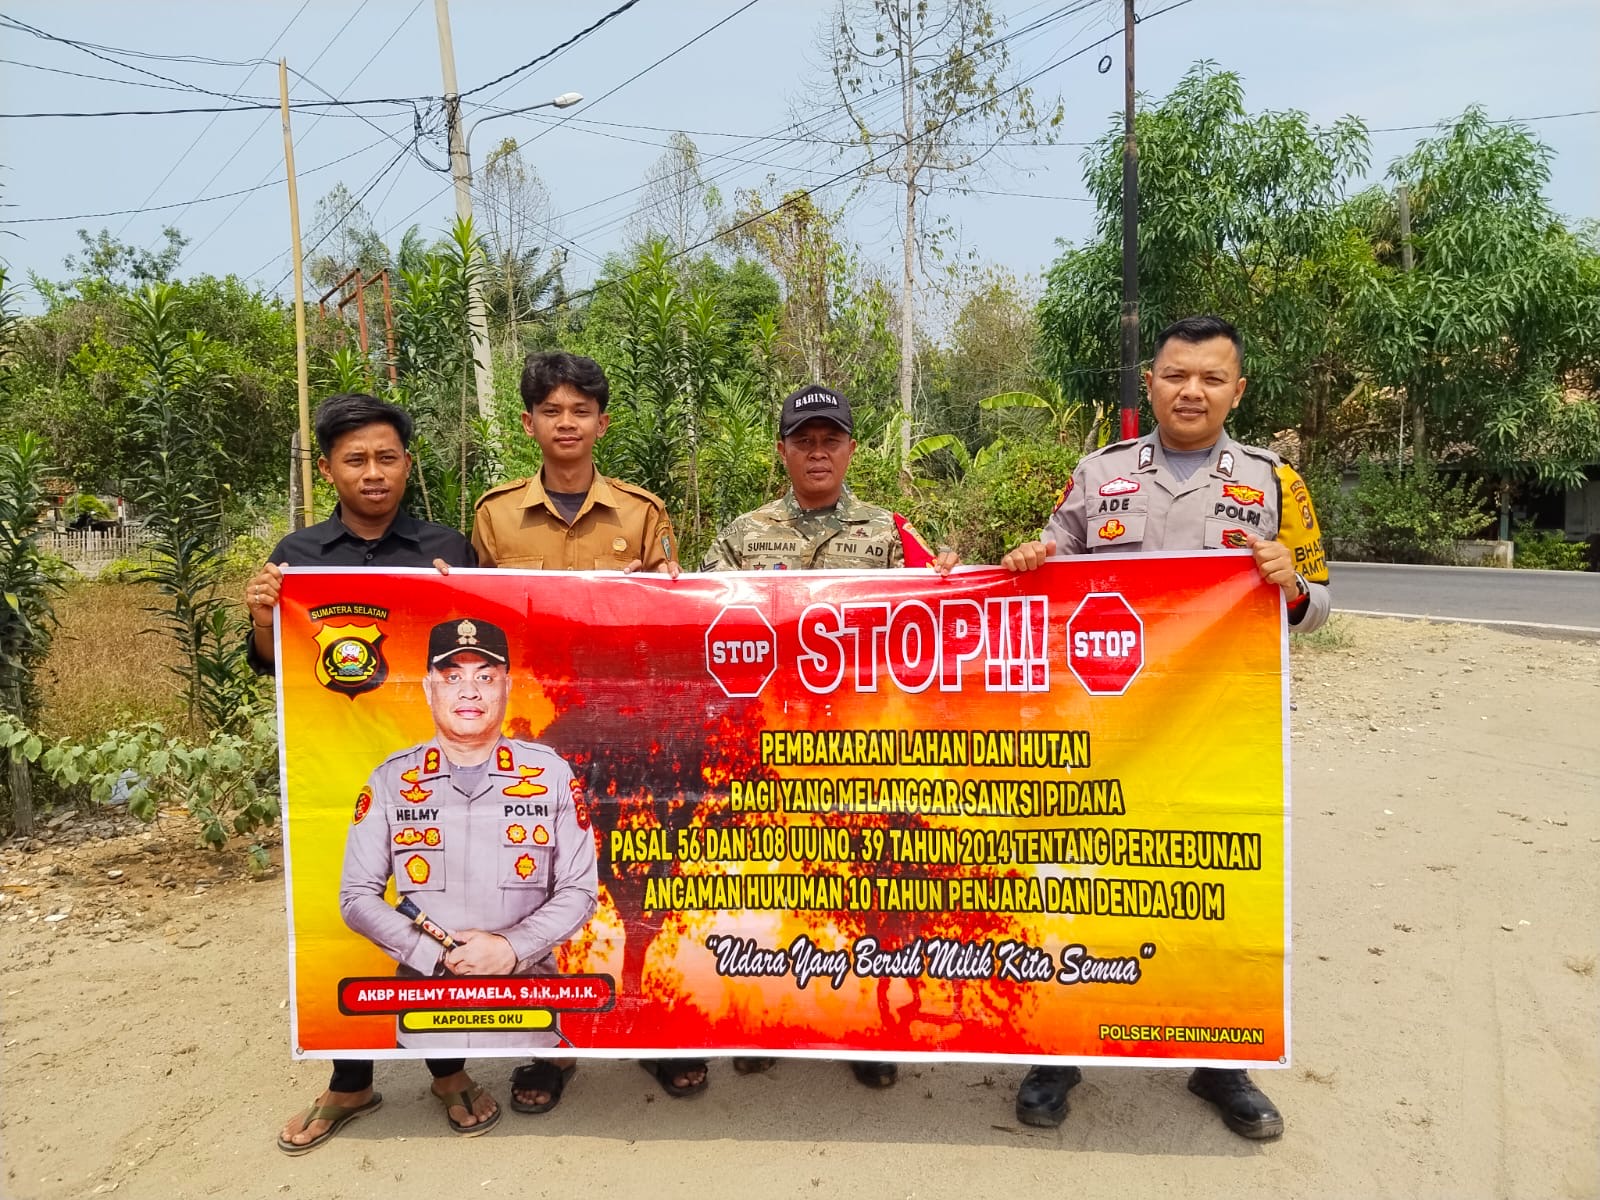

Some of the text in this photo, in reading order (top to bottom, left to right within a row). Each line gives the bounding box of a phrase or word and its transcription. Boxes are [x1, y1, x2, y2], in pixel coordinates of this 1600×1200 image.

[795, 393, 838, 408] BABINSA
[1099, 498, 1130, 513] ADE
[1214, 502, 1261, 526] POLRI
[748, 542, 796, 551] SUHILMAN
[835, 543, 883, 557] TNI AD
[311, 605, 387, 619] SUMATERA SELATAN
[712, 640, 770, 664] STOP
[797, 595, 1050, 695] STOP!!!
[1074, 630, 1137, 657] STOP
[761, 731, 1089, 767] PEMBAKARAN LAHAN DAN HUTAN
[730, 780, 1124, 816] BAGI YANG MELANGGAR SANKSI PIDANA
[396, 809, 440, 821] HELMY
[504, 804, 548, 817] POLRI
[610, 828, 1260, 870] PASAL 56 DAN 108 UU NO. 39 TAHUN 2014 TENTANG PERKEBUNAN
[644, 876, 1224, 919] ANCAMAN HUKUMAN 10 TAHUN PENJARA DAN DENDA 10 M
[790, 937, 850, 986] Yang
[855, 940, 922, 977] Bersih
[927, 942, 993, 979] Milik
[998, 944, 1053, 981] Kita
[357, 990, 395, 1002] AKBP
[398, 989, 444, 1001] HELMY
[448, 987, 517, 1000] TAMAELA,
[433, 1014, 523, 1025] KAPOLRES OKU
[1100, 1025, 1264, 1043] POLSEK PENINJAUAN
